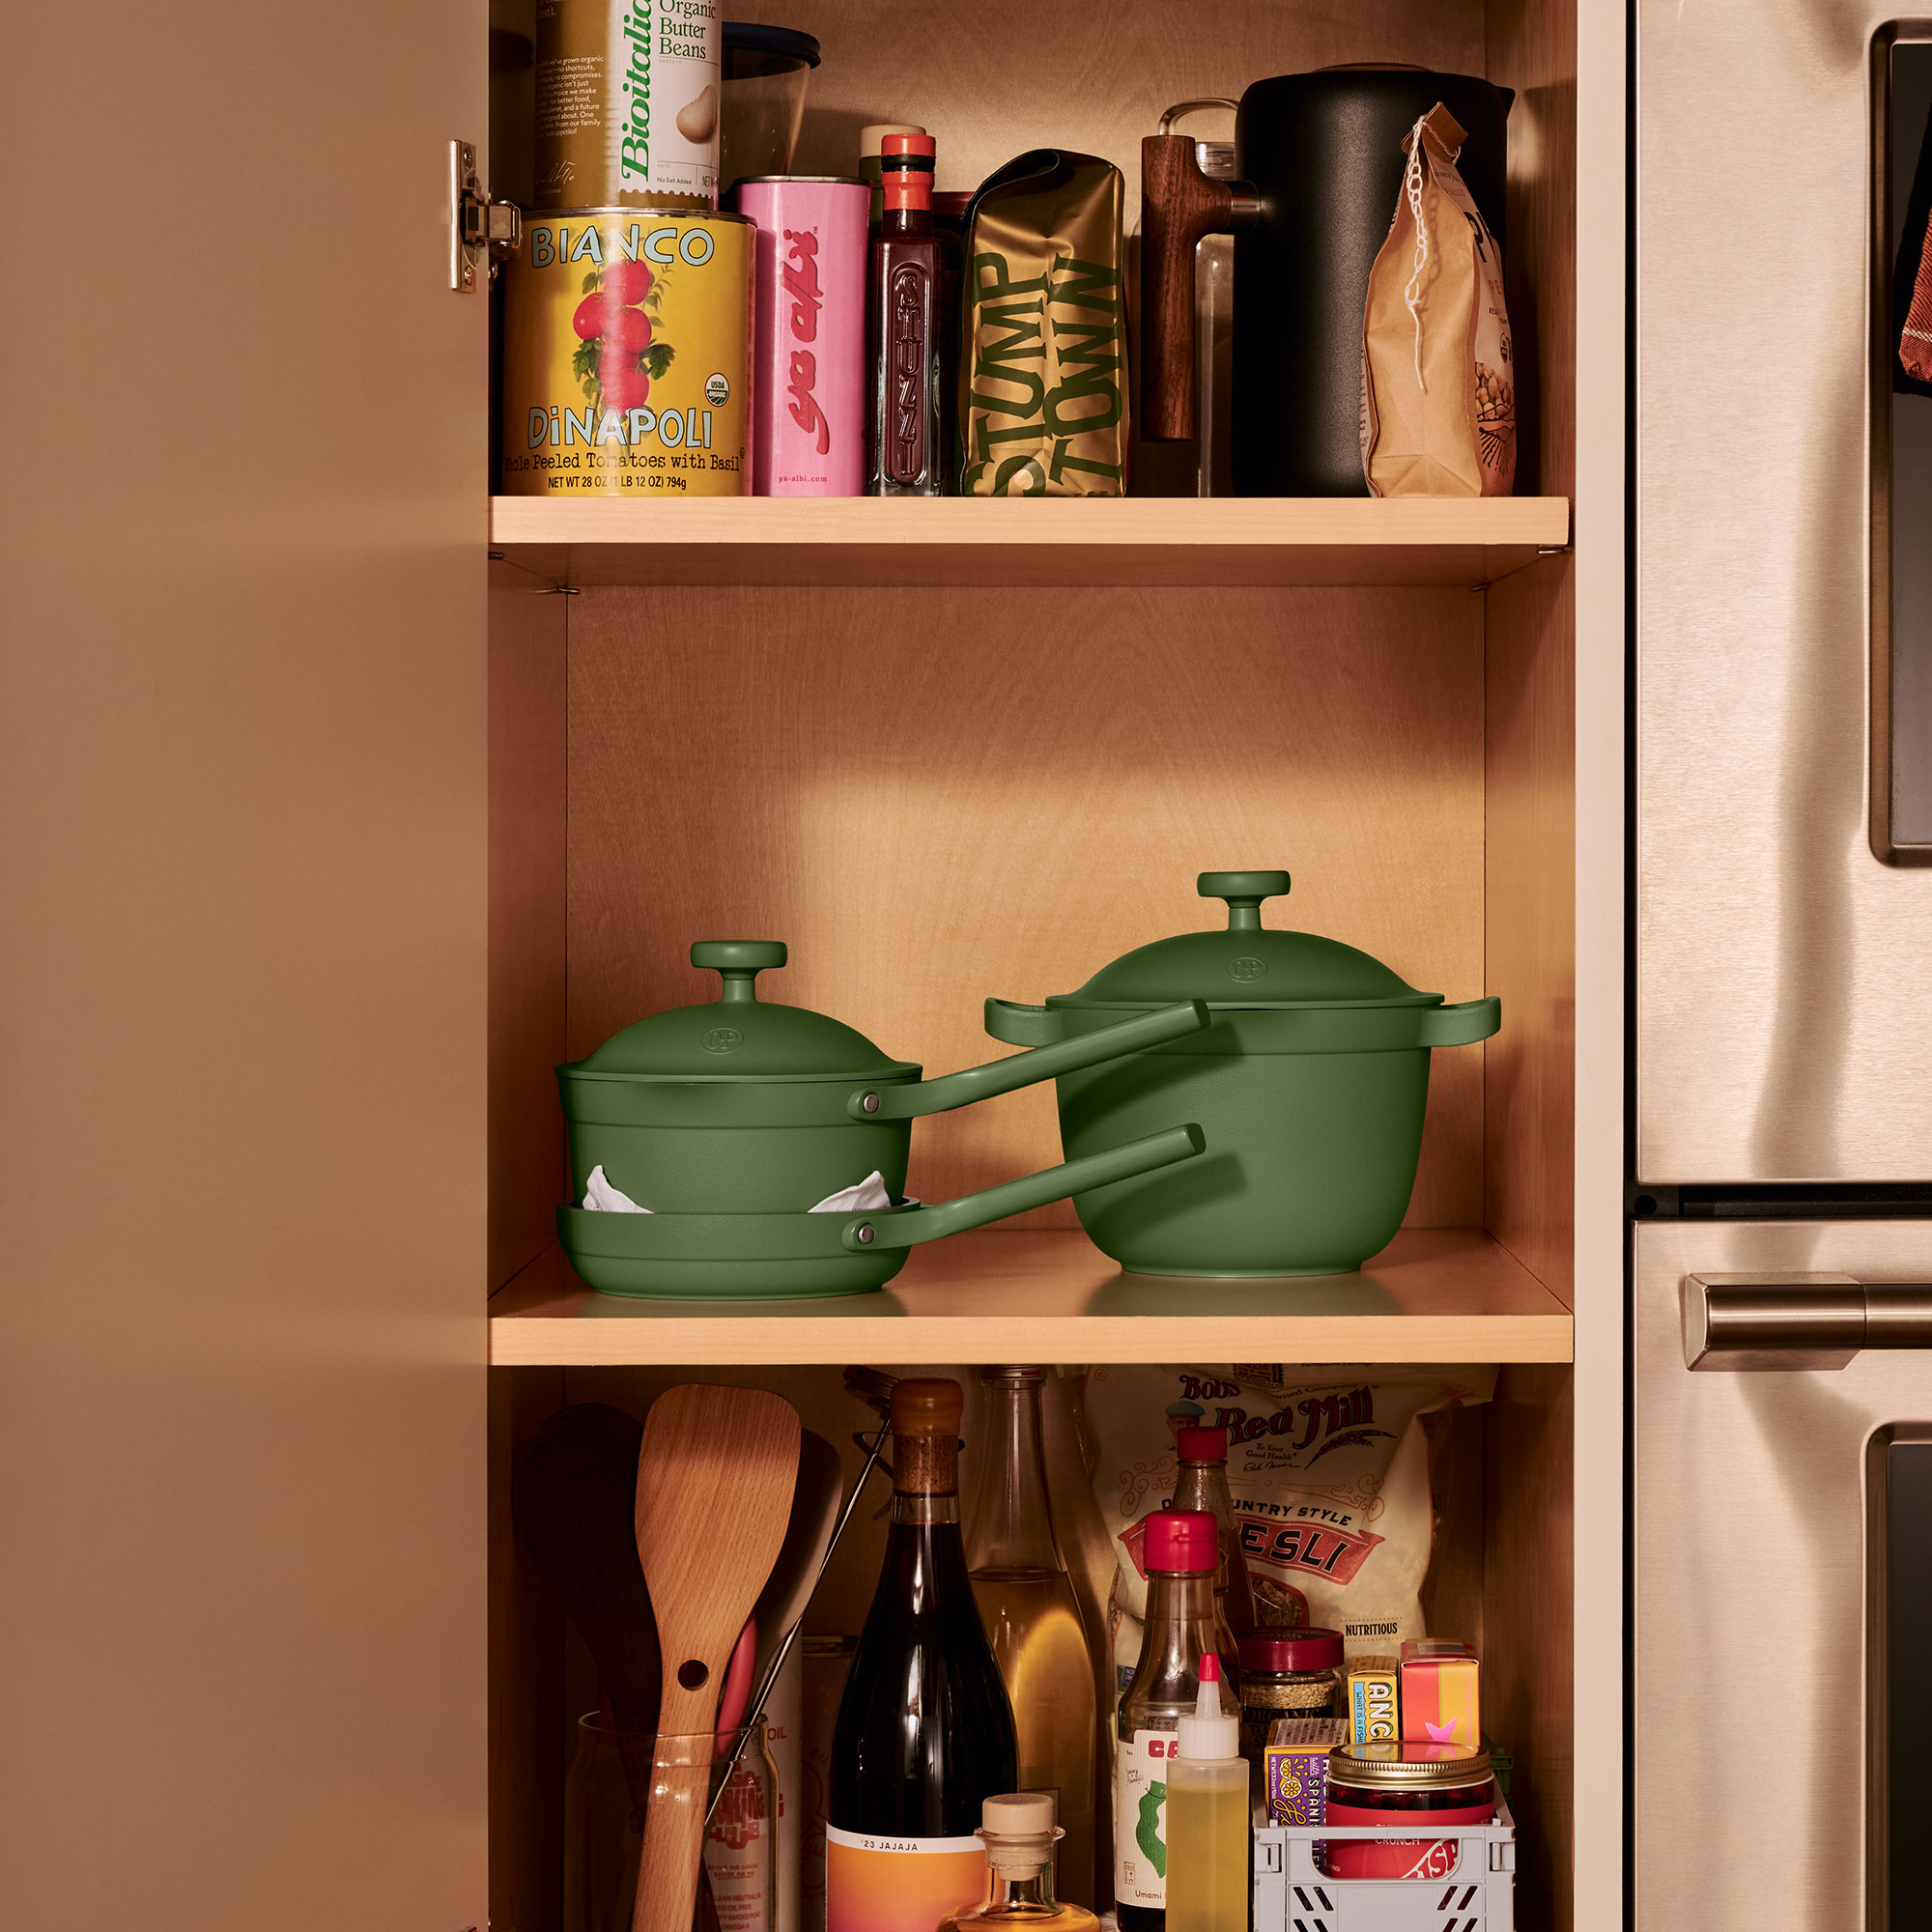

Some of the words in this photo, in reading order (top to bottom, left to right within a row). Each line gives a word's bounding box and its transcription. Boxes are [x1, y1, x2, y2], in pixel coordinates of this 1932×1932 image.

[660, 0, 716, 19] Organic
[660, 17, 706, 39] Butter
[660, 38, 706, 59] Beans
[562, 57, 579, 66] grown
[580, 55, 604, 64] organic
[561, 72, 603, 82] compromises.
[530, 223, 714, 268] BIANCO
[896, 274, 922, 476] STUZZI
[964, 252, 1049, 497] STUMP
[1042, 252, 1123, 486] TOWN
[711, 381, 725, 389] USDA
[532, 453, 581, 470] Peeled
[586, 452, 666, 469] Tomatoes
[670, 453, 706, 469] with
[710, 454, 740, 471] Basil
[549, 476, 563, 488] NET
[565, 476, 580, 488] WT
[582, 476, 592, 487] 28
[595, 476, 608, 487] OZ
[621, 476, 633, 487] LB
[636, 476, 645, 487] 12
[648, 476, 664, 488] OZ)
[667, 476, 687, 490] 794g
[1215, 1406, 1293, 1446] Red
[1293, 1386, 1374, 1449] Mill
[1246, 1450, 1265, 1459] Good
[1267, 1452, 1293, 1461] Health
[1231, 1499, 1293, 1518] UNTRY
[1296, 1506, 1352, 1526] STYLE
[1239, 1521, 1350, 1574] ESLI
[1346, 1622, 1398, 1636] NUTRITIOUS
[1368, 1682, 1394, 1741] ANC
[767, 1727, 787, 1741] OIL
[1309, 1756, 1321, 1776] with
[879, 1841, 918, 1851] JAJAJA
[1135, 1889, 1162, 1899] Umami
